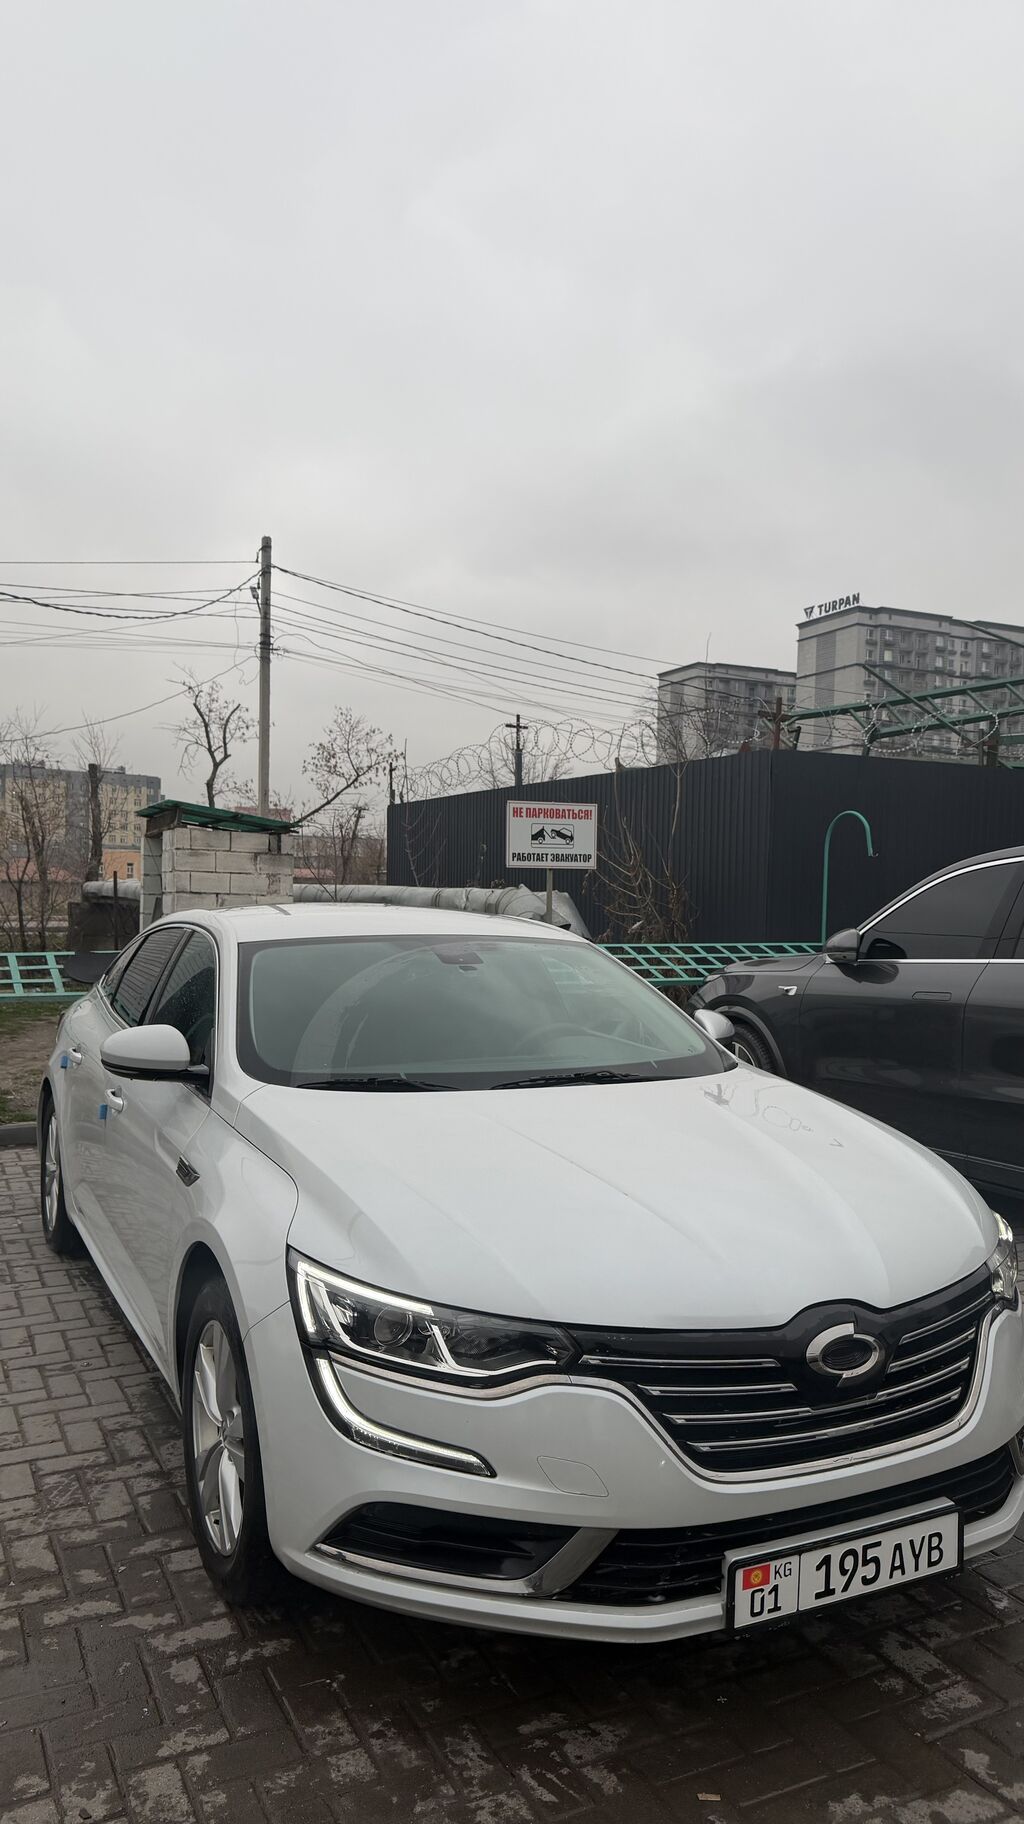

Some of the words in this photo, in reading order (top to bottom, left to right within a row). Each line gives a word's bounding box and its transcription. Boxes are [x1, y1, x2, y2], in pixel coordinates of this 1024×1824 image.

[818, 592, 860, 615] TURPAN
[512, 807, 524, 818] НЕ
[525, 807, 593, 820] ПАРКОВАТЬСЯ!
[512, 852, 549, 862] РАБОТАЕТ
[550, 853, 592, 863] ЭВАКУАТОР
[774, 1561, 792, 1580] KG
[814, 1540, 882, 1600] 195
[889, 1531, 944, 1579] AYB
[749, 1583, 782, 1618] 01
